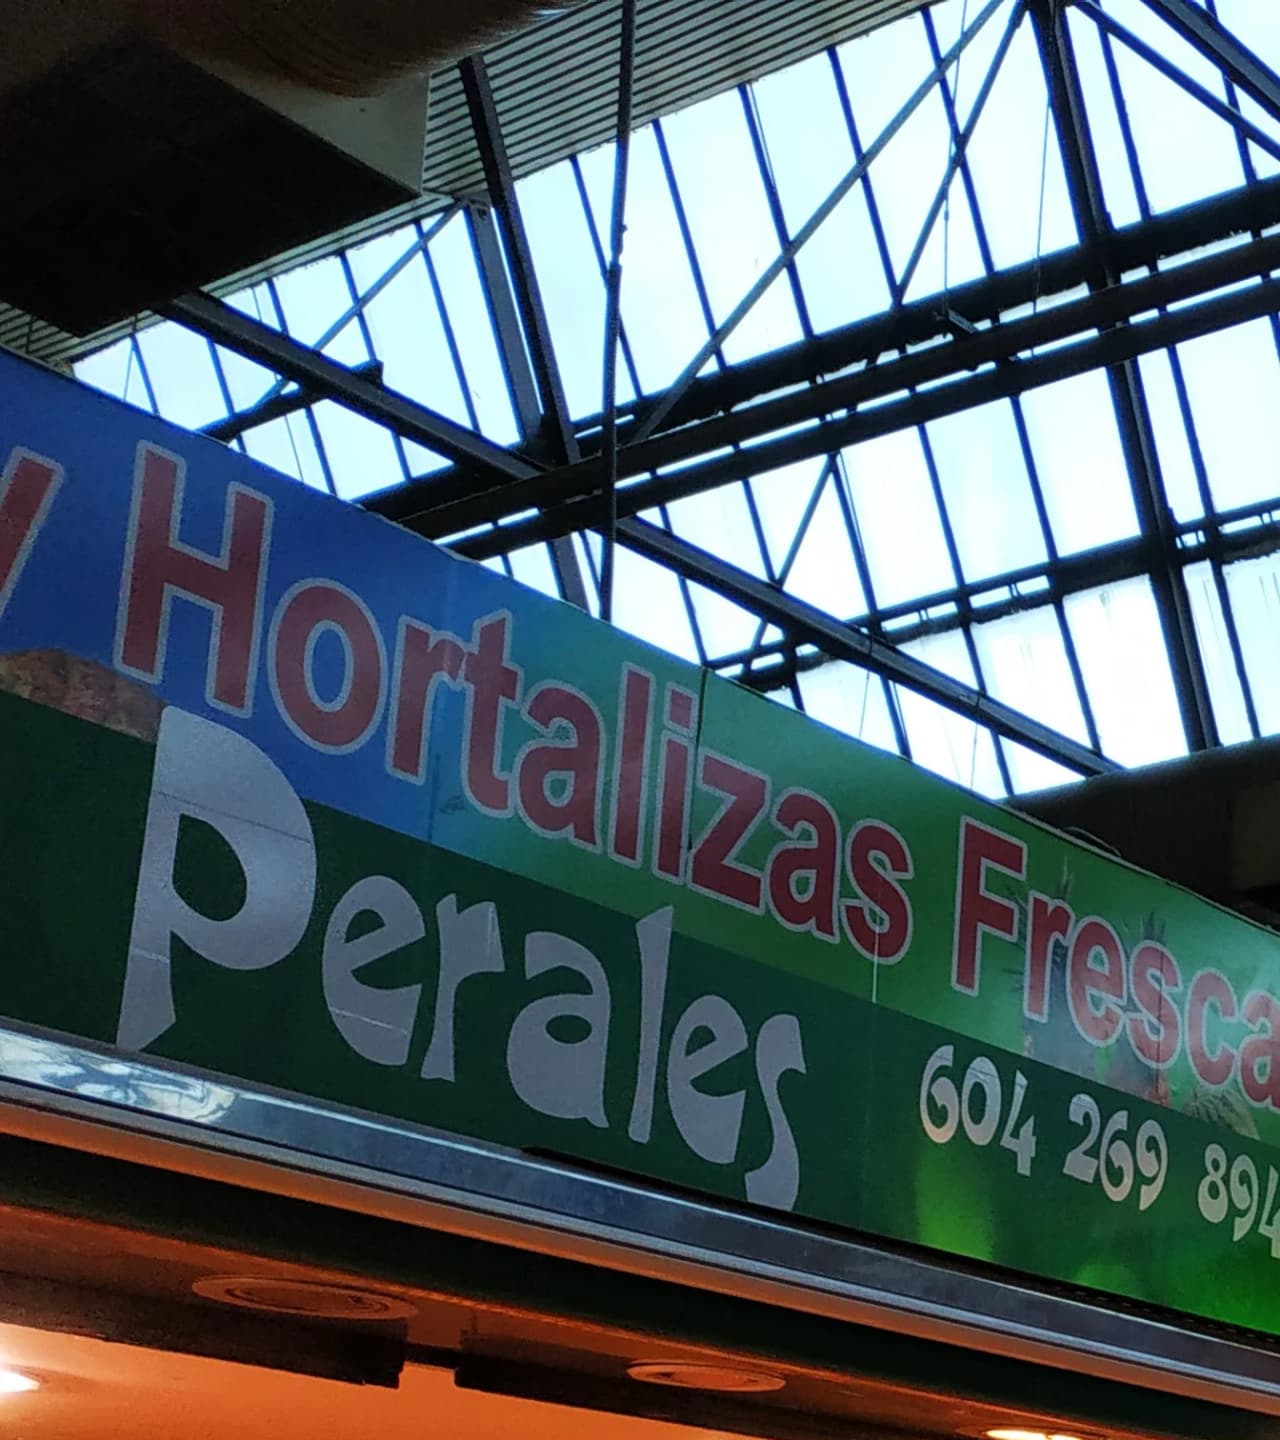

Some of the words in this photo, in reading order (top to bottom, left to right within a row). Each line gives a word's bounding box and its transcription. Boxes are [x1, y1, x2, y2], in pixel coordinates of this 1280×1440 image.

[114, 440, 914, 965] Hortalizas
[116, 706, 806, 1212] Perales
[920, 1044, 1036, 1176] 604
[1063, 1093, 1167, 1211] 269
